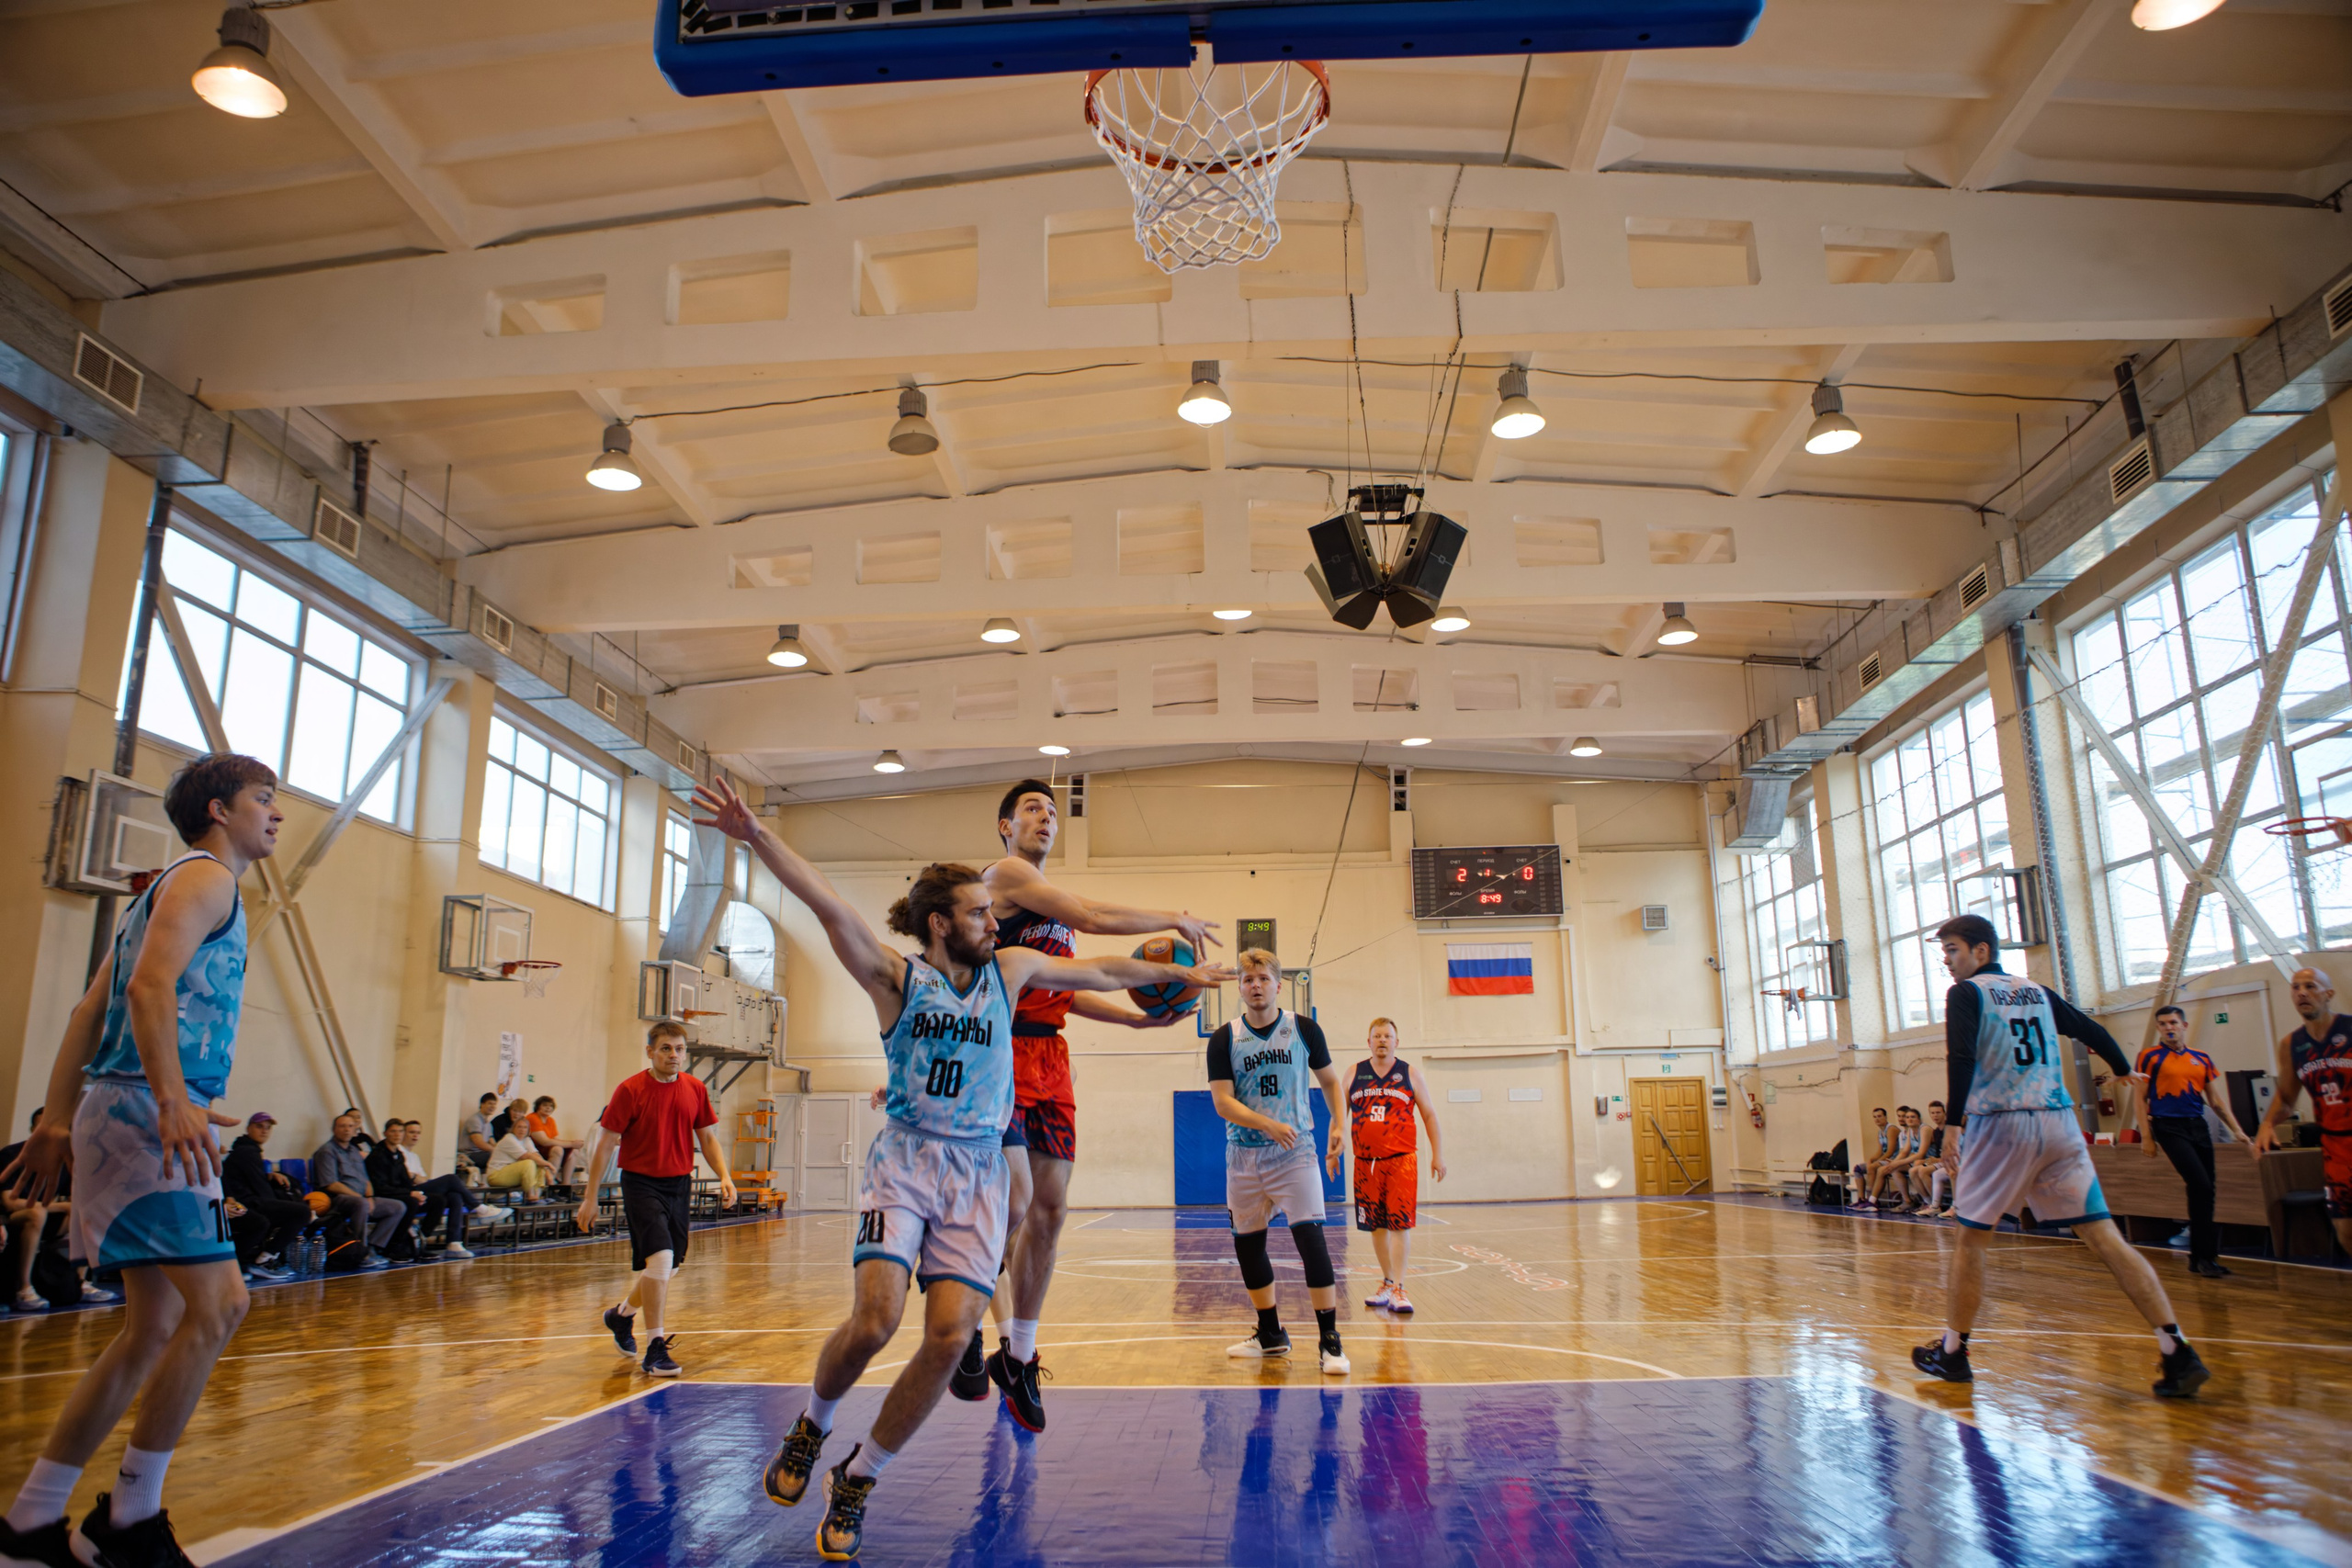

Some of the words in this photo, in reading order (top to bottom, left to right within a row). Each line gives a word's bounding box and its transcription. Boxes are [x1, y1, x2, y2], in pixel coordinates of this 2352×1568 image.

[1457, 868, 1467, 882] 2
[1523, 866, 1533, 880] 0
[1480, 894, 1502, 903] 8:49
[1048, 924, 1069, 944] STATE
[1248, 922, 1270, 931] 8:49
[914, 978, 946, 989] fruitit
[911, 1012, 992, 1047] ВАРАНЫ
[2009, 1017, 2048, 1066] 31
[1243, 1049, 1292, 1072] ВАРАНЫ
[926, 1058, 963, 1099] 00
[1261, 1075, 1278, 1097] 69
[1364, 1089, 1383, 1097] STATE
[1370, 1105, 1385, 1122] 59
